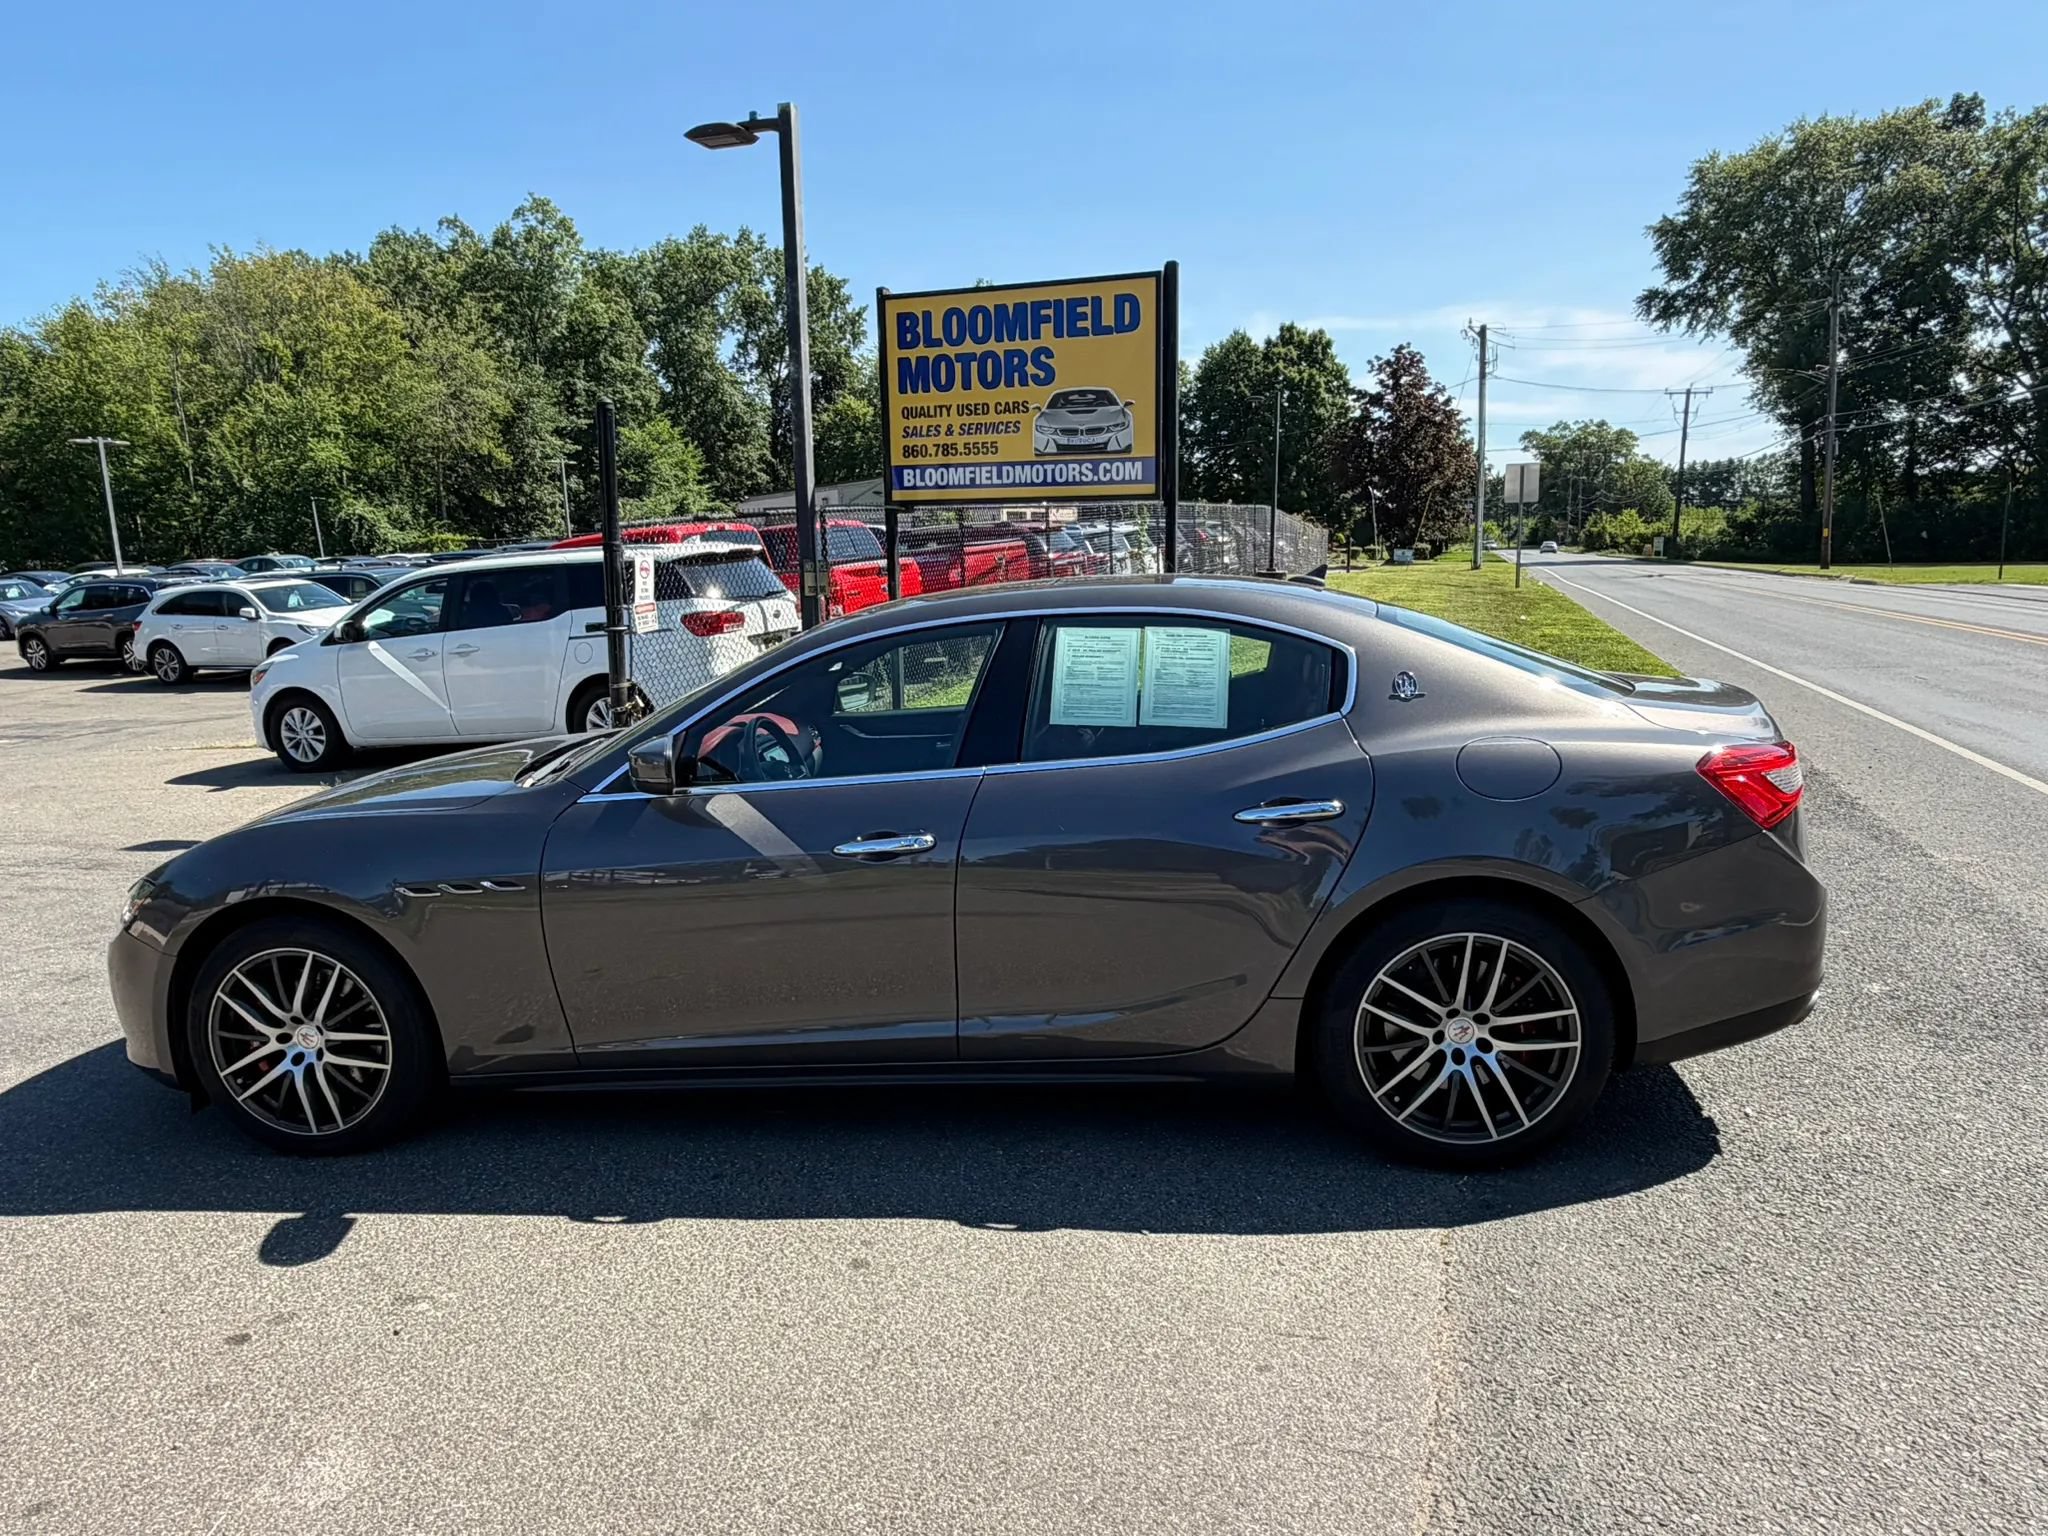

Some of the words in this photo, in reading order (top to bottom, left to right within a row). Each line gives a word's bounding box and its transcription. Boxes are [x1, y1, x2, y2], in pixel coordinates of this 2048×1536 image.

[896, 293, 1141, 350] BLOOMFIELD
[897, 346, 1056, 394] MOTORS
[901, 404, 952, 420] QUALITY
[956, 401, 990, 416] USED
[994, 400, 1030, 415] CARS
[902, 423, 942, 438] SALES
[945, 422, 954, 436] &
[958, 420, 1021, 435] SERVICES
[902, 441, 999, 458] 860.785.5555
[903, 462, 1143, 487] BLOOMFIELDMOTORS.COM
